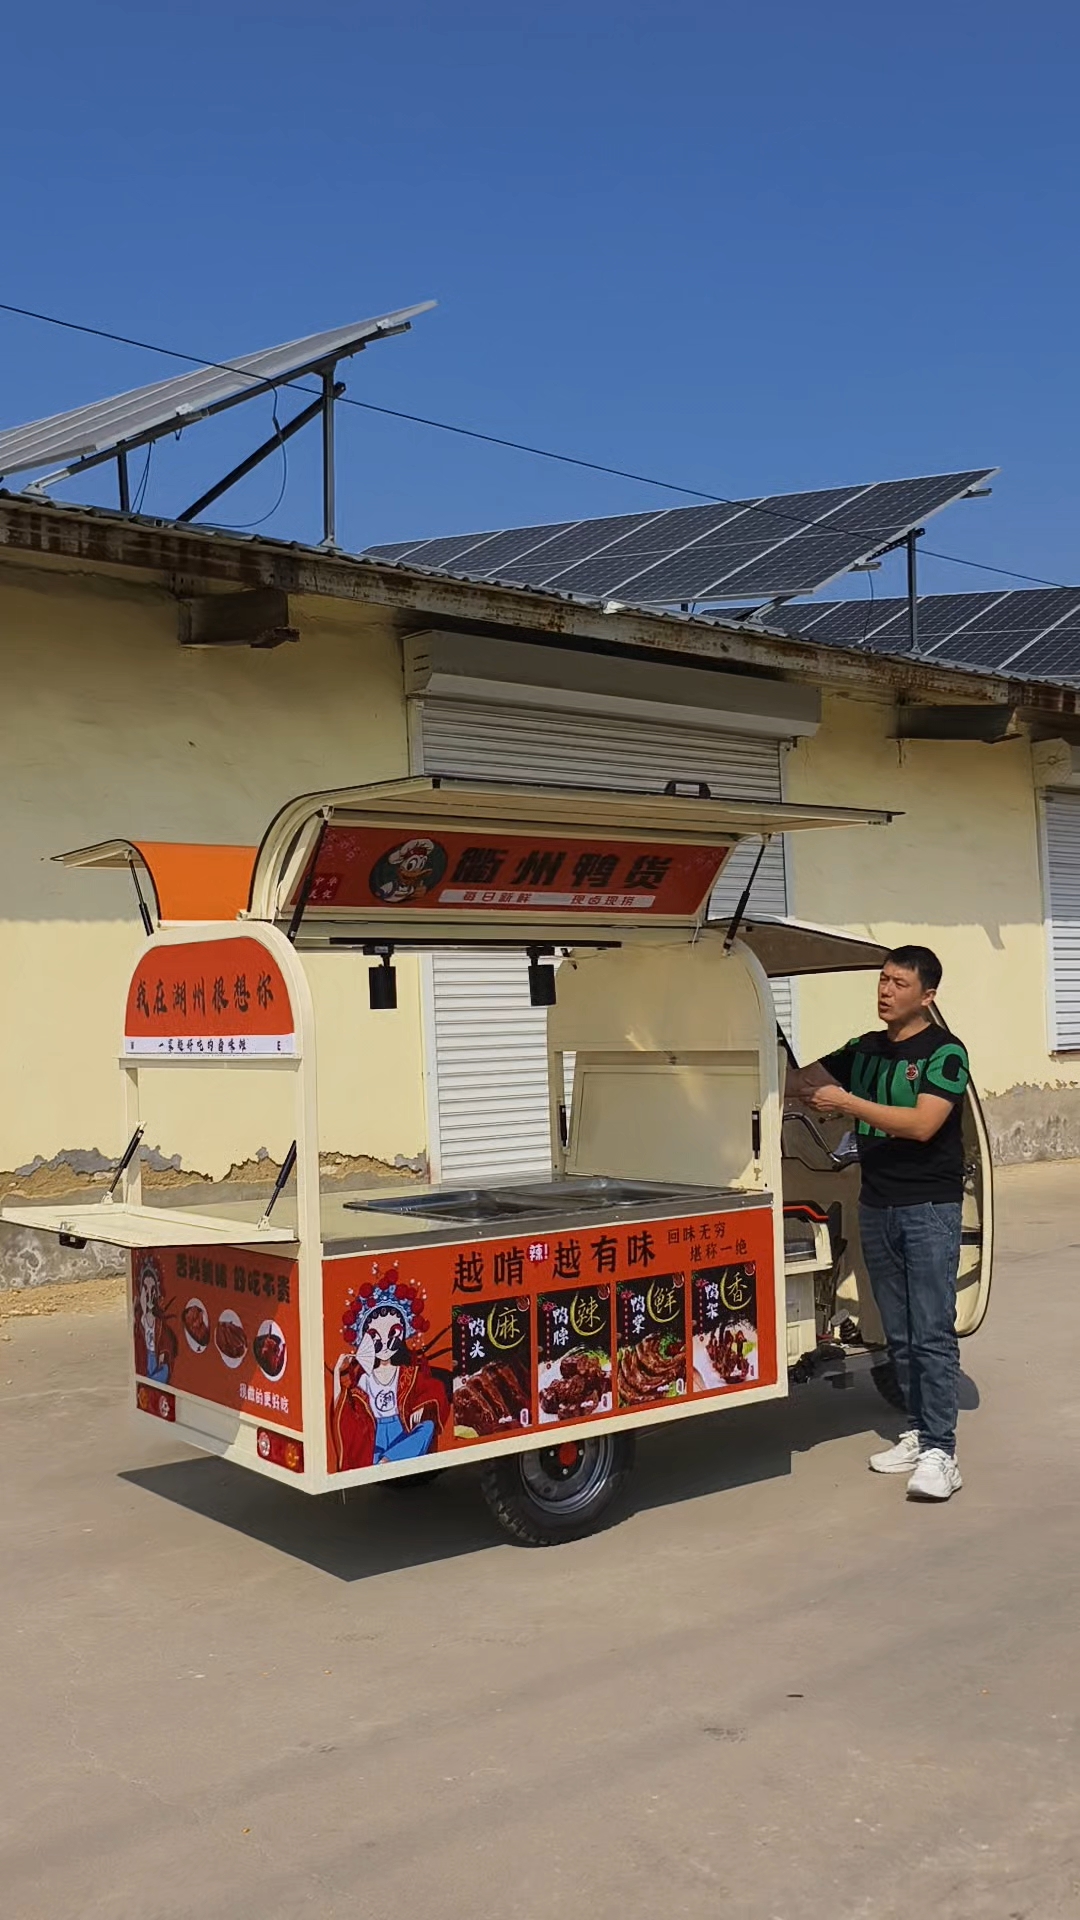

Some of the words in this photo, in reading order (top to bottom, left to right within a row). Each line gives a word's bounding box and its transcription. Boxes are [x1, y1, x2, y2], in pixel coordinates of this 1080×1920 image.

[463, 891, 532, 903] 每日新鲜
[667, 1221, 726, 1245] 回味无穷
[452, 1246, 525, 1295] 越啃
[551, 1230, 657, 1280] 越有味
[690, 1238, 748, 1263] 堪称一绝
[653, 1286, 677, 1315] 鲜
[726, 1271, 749, 1303] 香
[493, 1307, 521, 1340] 麻
[575, 1296, 601, 1328] 辣
